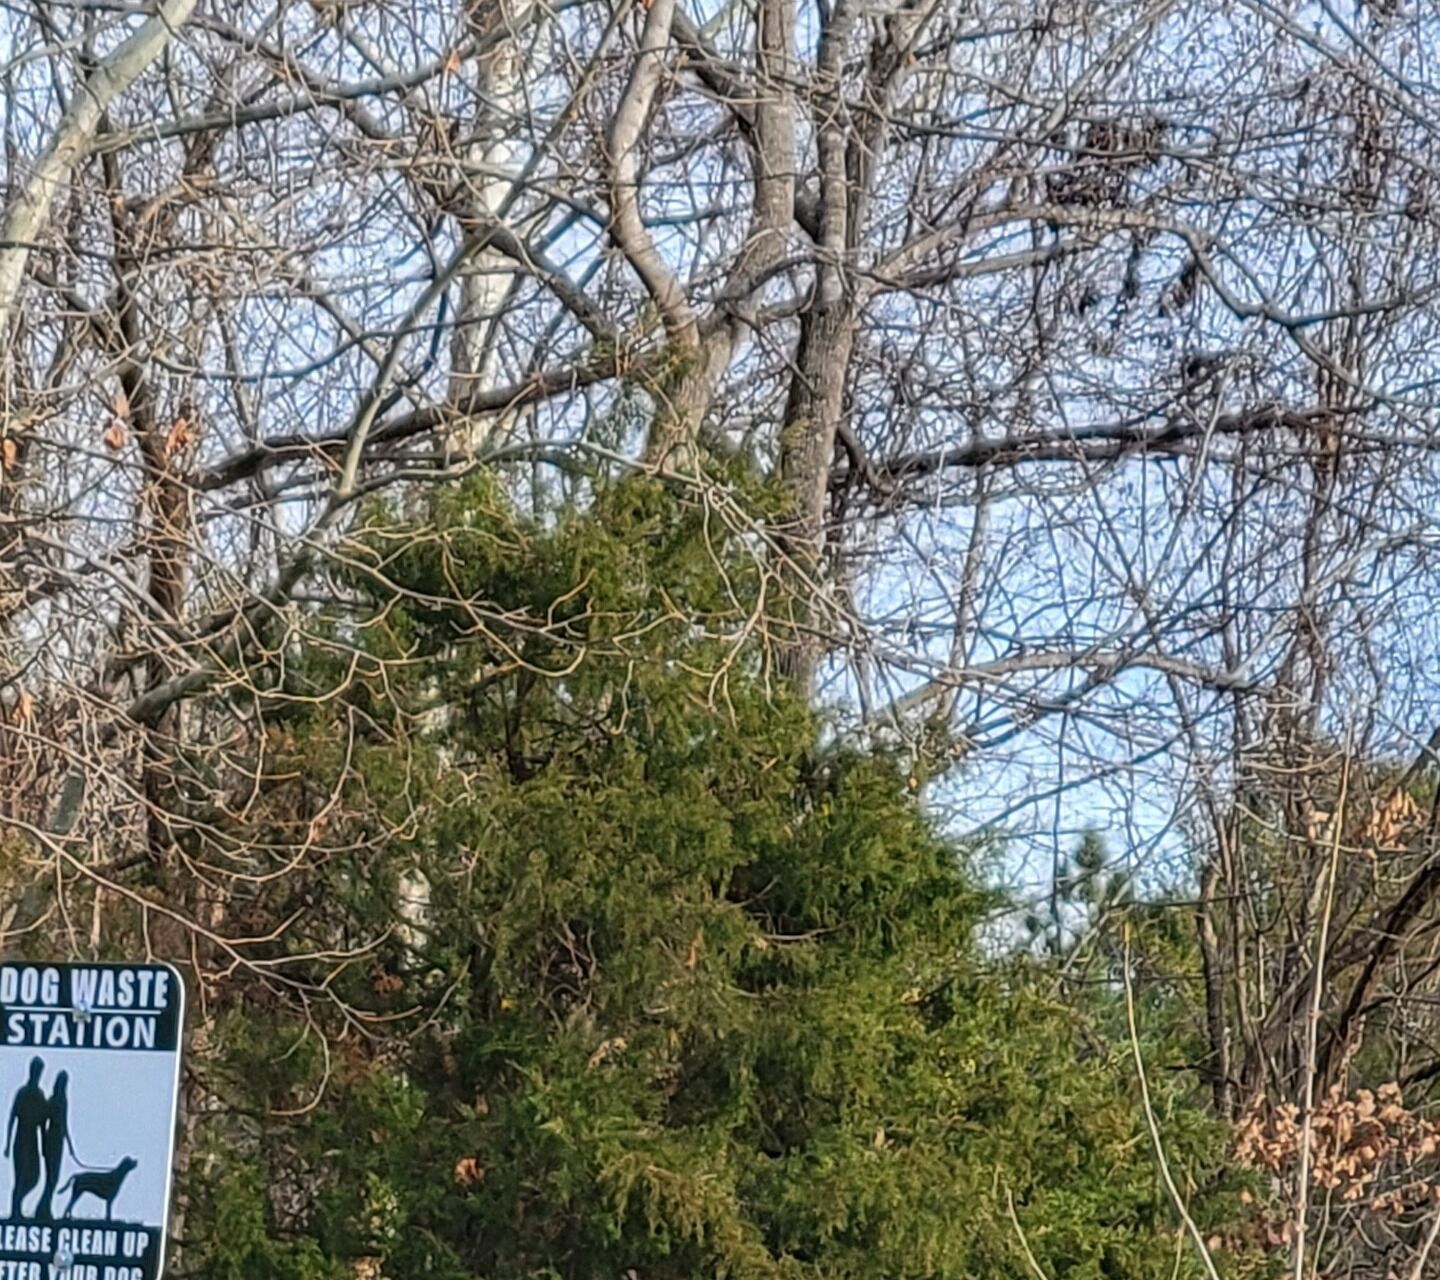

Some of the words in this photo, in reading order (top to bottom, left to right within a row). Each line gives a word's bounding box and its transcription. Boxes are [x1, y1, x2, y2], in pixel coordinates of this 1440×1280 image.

[0, 967, 60, 1004] DOG
[71, 969, 169, 1008] WASTE
[7, 1013, 156, 1047] STATION
[58, 1227, 117, 1256] CLEAN
[123, 1231, 148, 1258] UP
